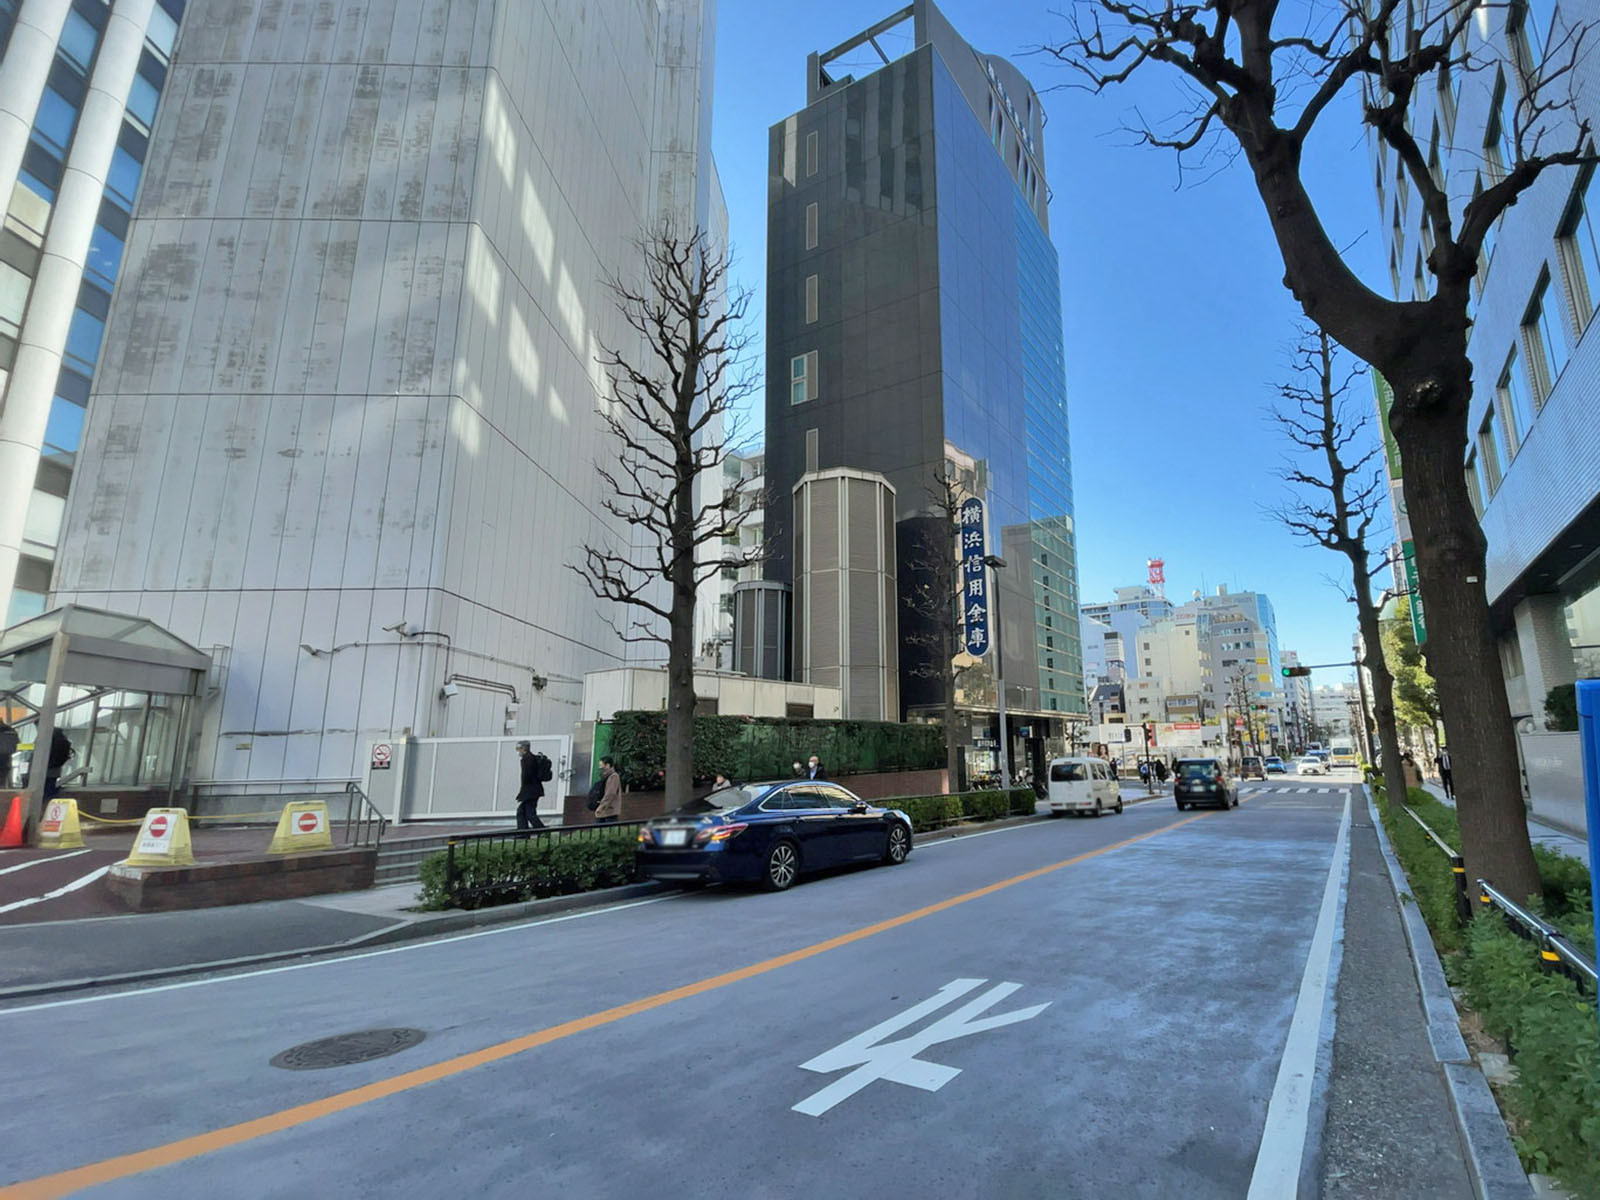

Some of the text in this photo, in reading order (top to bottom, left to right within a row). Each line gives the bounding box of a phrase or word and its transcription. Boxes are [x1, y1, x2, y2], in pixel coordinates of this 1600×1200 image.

[962, 505, 987, 648] 横浜信用金庫
